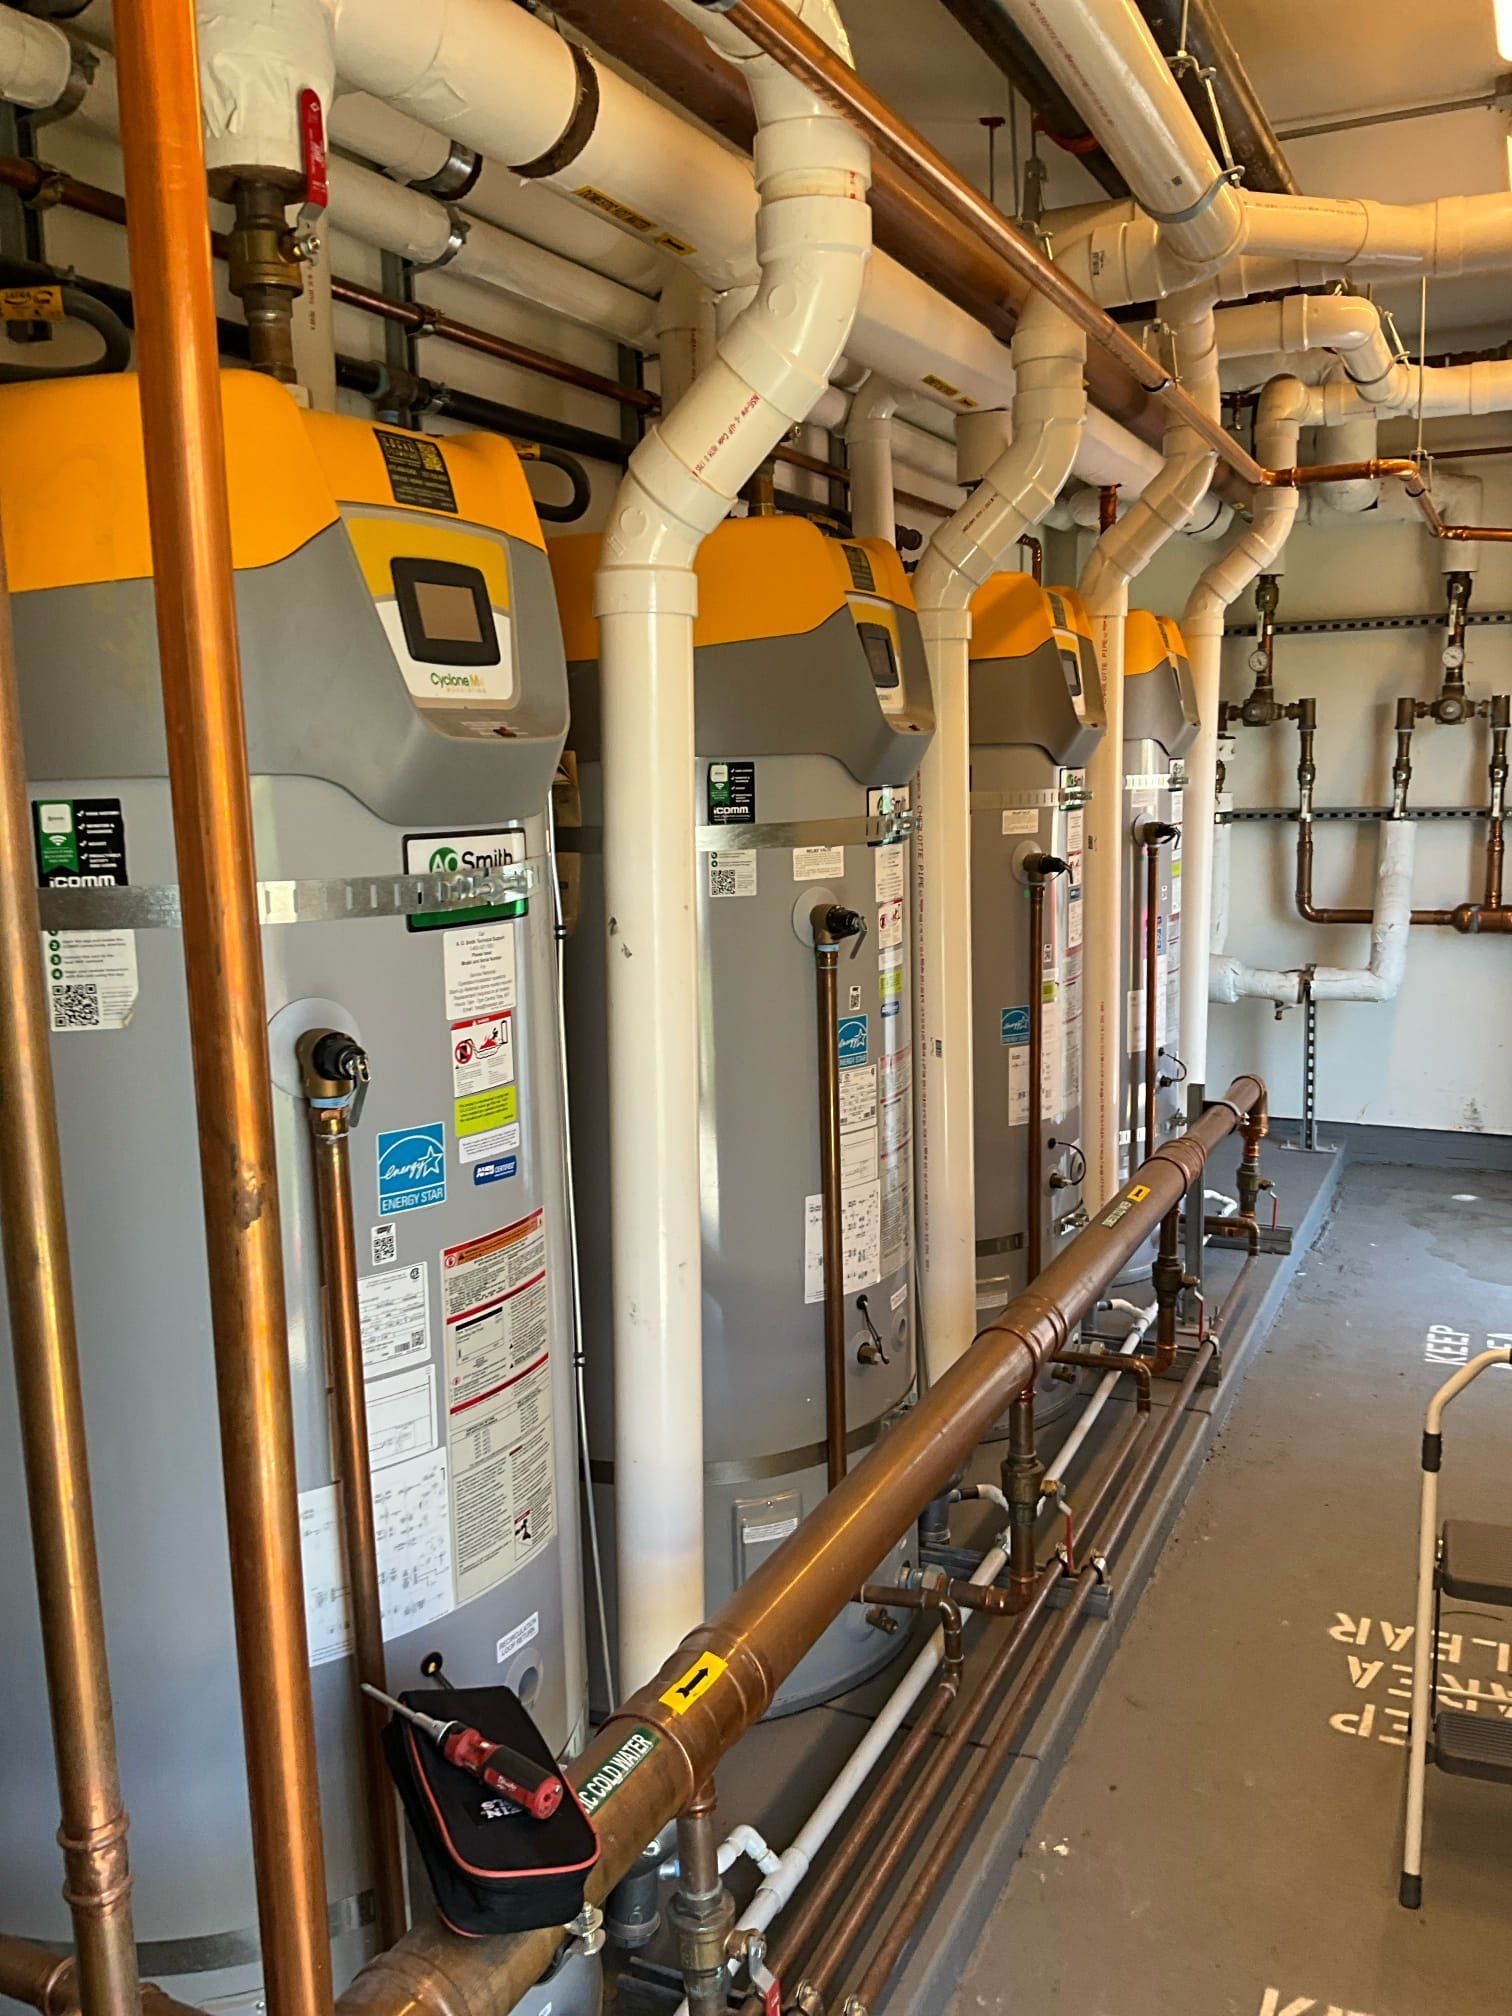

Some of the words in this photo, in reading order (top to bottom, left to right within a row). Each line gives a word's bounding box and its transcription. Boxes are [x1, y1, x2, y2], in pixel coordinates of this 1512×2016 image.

[430, 672, 470, 688] Cyclone
[462, 848, 513, 870] Smith
[381, 1160, 428, 1180] energy
[382, 1194, 420, 1211] ENERGY
[420, 1187, 444, 1203] STAR
[1424, 1324, 1470, 1366] KEEP
[586, 1765, 623, 1798] COLD
[610, 1733, 653, 1772] WATER
